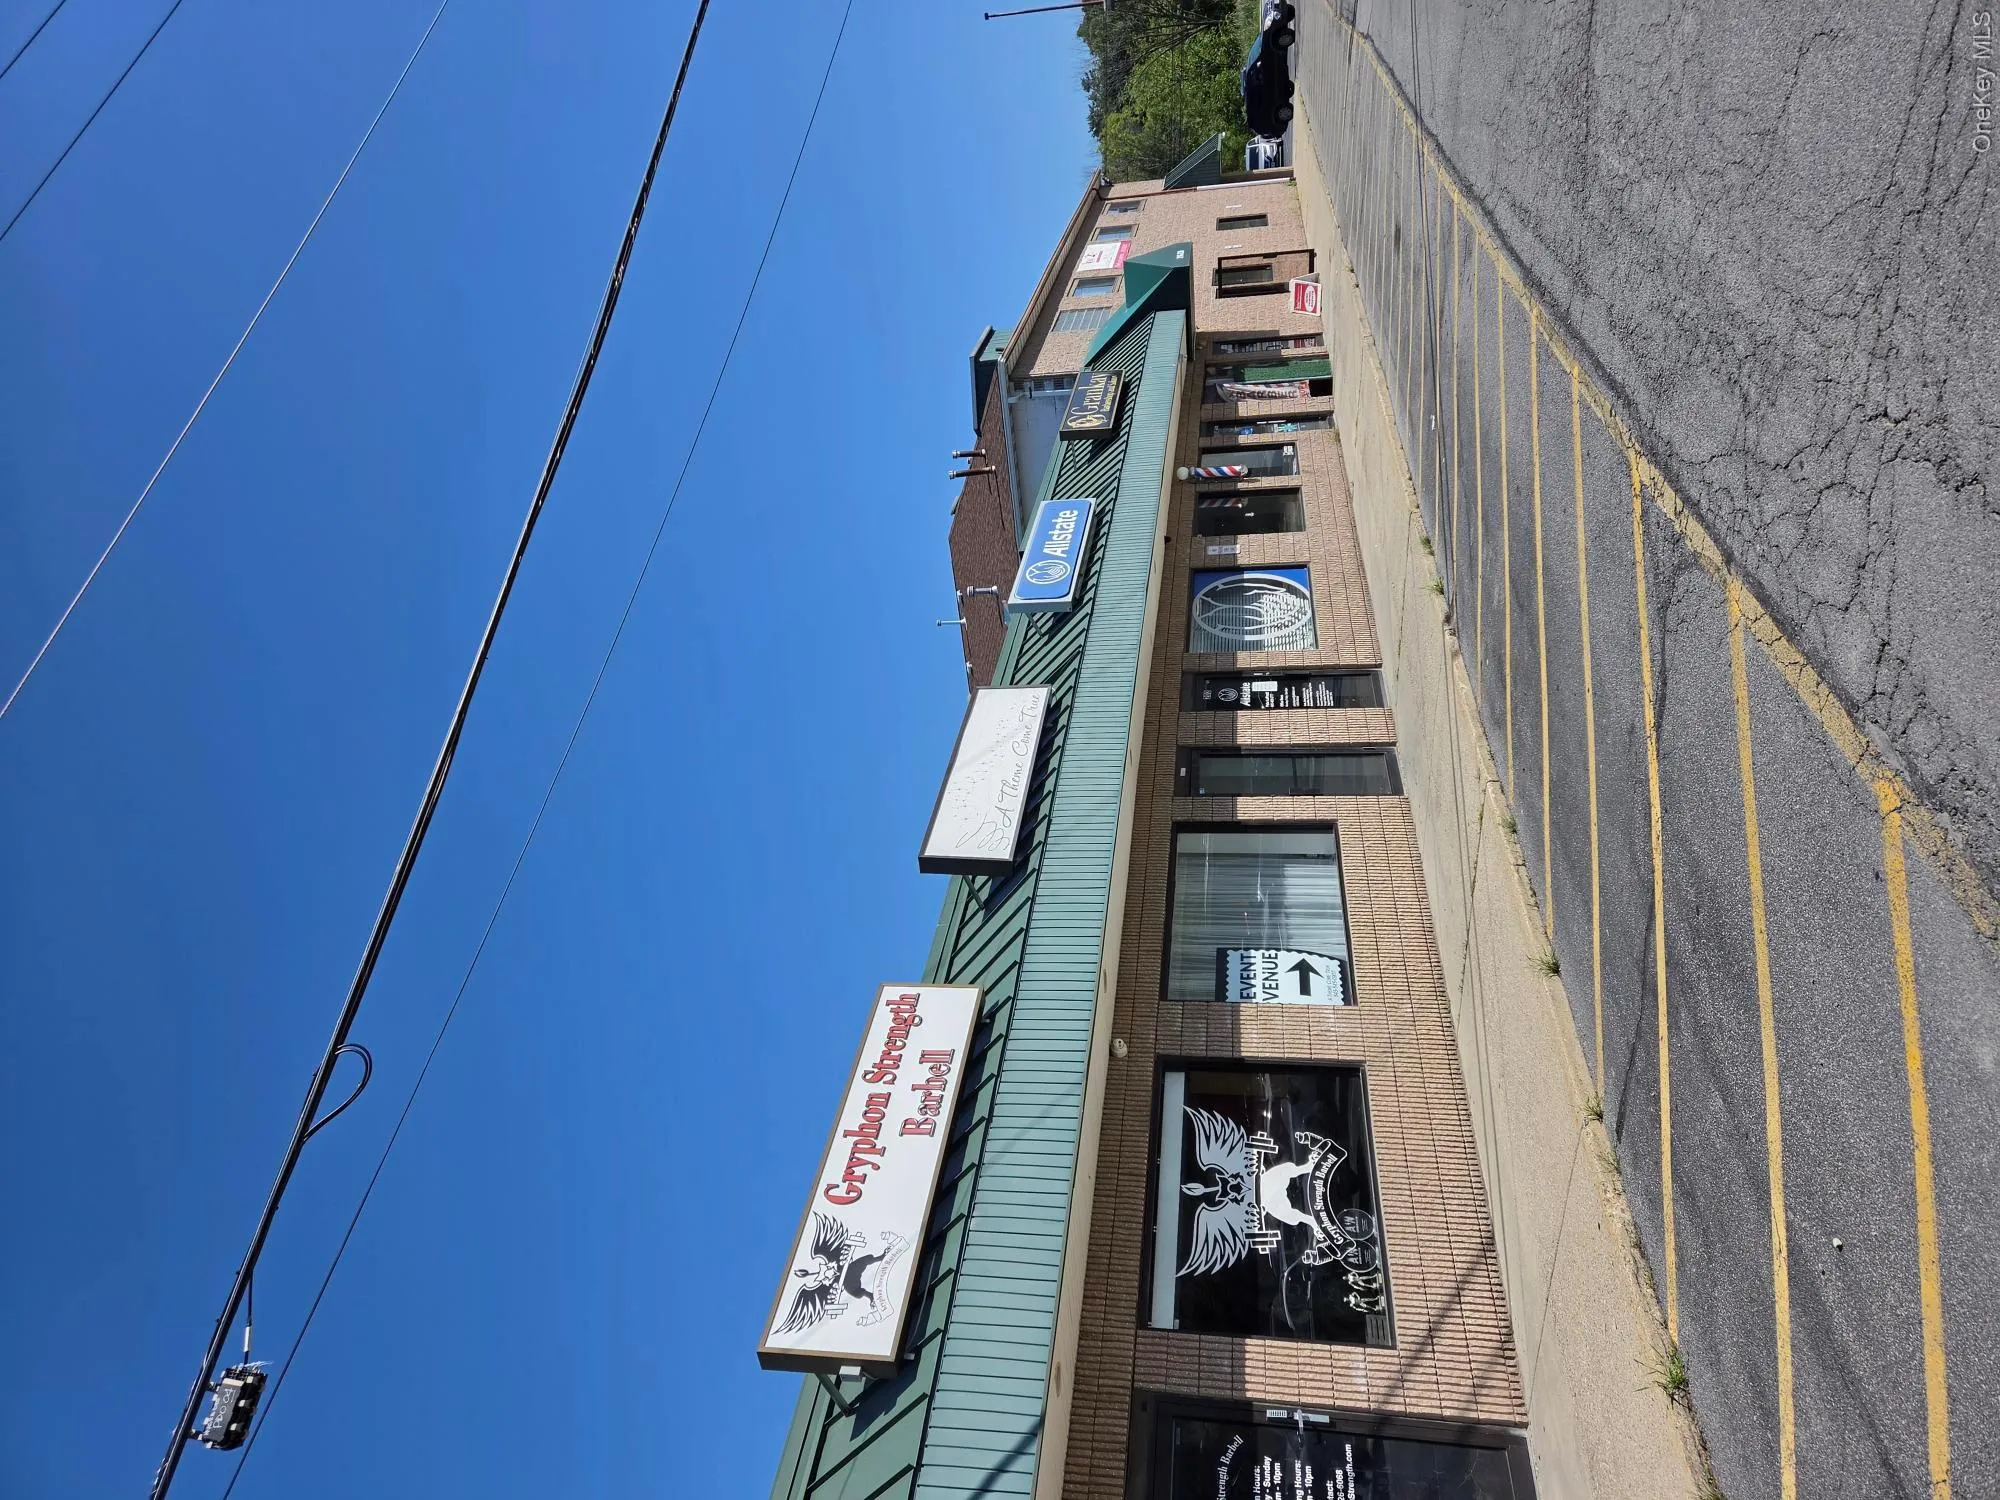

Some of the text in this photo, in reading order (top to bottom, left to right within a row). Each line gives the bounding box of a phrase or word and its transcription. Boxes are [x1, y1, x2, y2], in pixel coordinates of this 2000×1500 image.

[1042, 510, 1078, 558] Allstate
[1240, 682, 1251, 706] Allstate
[995, 692, 1040, 828] A Theme Come True
[1240, 953, 1256, 1000] EVENT
[1262, 952, 1279, 1002] VENUE
[824, 992, 922, 1205] Gryphon Strength
[898, 1048, 954, 1137] Barbell
[1313, 1153, 1344, 1244] Gryphon Strength Barbell
[1216, 1434, 1244, 1500] Strength Barbell
[1252, 1466, 1260, 1493] Hours:
[1262, 1456, 1272, 1487] Sunday
[1273, 1462, 1282, 1484] 10pm
[1294, 1460, 1302, 1488] Hours:
[1304, 1466, 1314, 1488] 10pm
[1326, 1480, 1334, 1500] tact:
